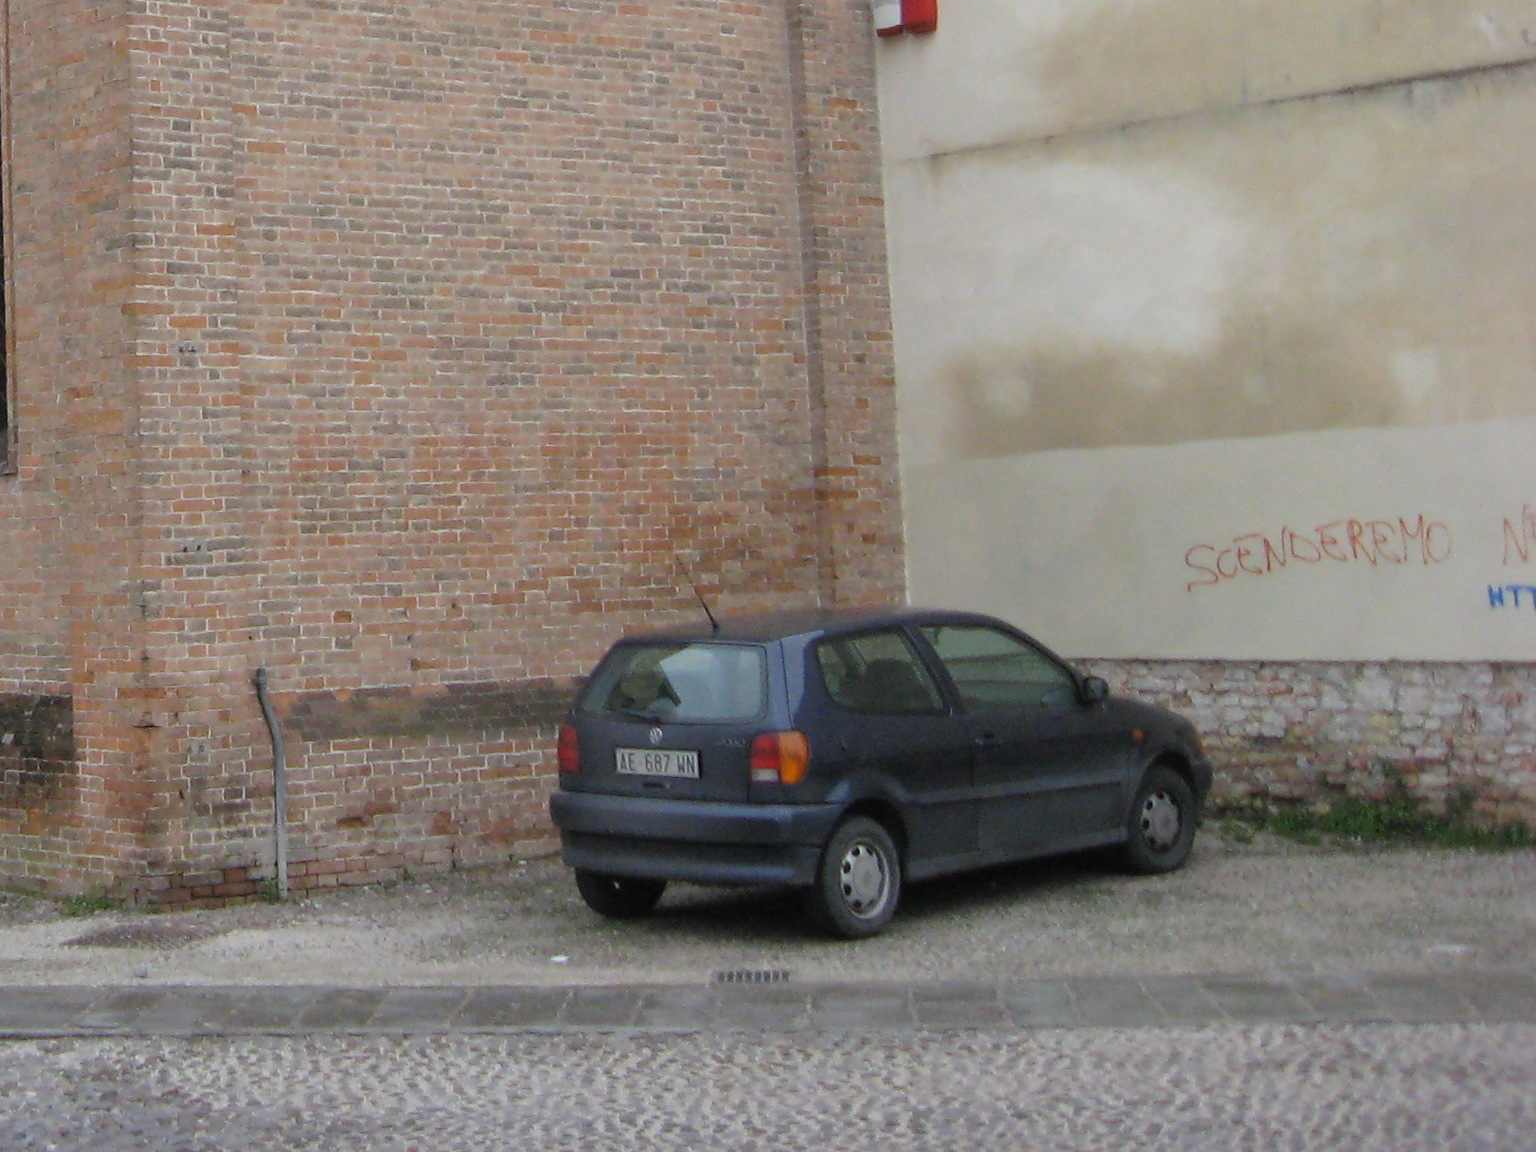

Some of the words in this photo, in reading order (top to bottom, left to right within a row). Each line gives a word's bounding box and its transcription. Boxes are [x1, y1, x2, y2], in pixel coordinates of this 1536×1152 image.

[1184, 513, 1452, 592] SCENDEREMO
[620, 752, 635, 771] AE
[645, 753, 671, 773] 687
[676, 754, 695, 774] WN
